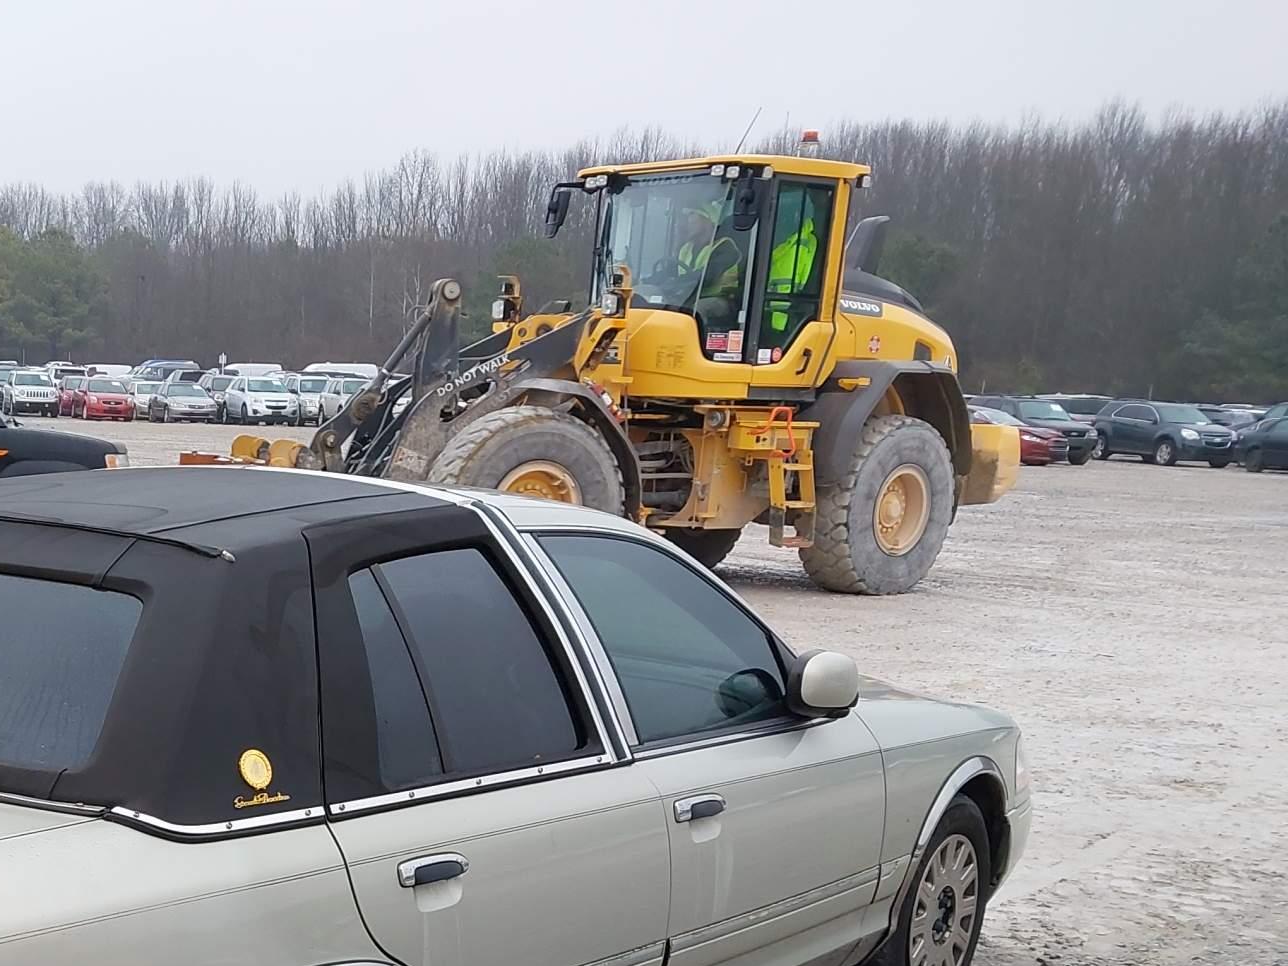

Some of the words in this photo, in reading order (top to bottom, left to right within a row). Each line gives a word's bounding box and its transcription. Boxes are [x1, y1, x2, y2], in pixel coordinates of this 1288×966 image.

[840, 299, 880, 313] VOLVO
[436, 383, 454, 397] DO
[454, 367, 479, 387] NOT
[477, 354, 511, 373] WALK
